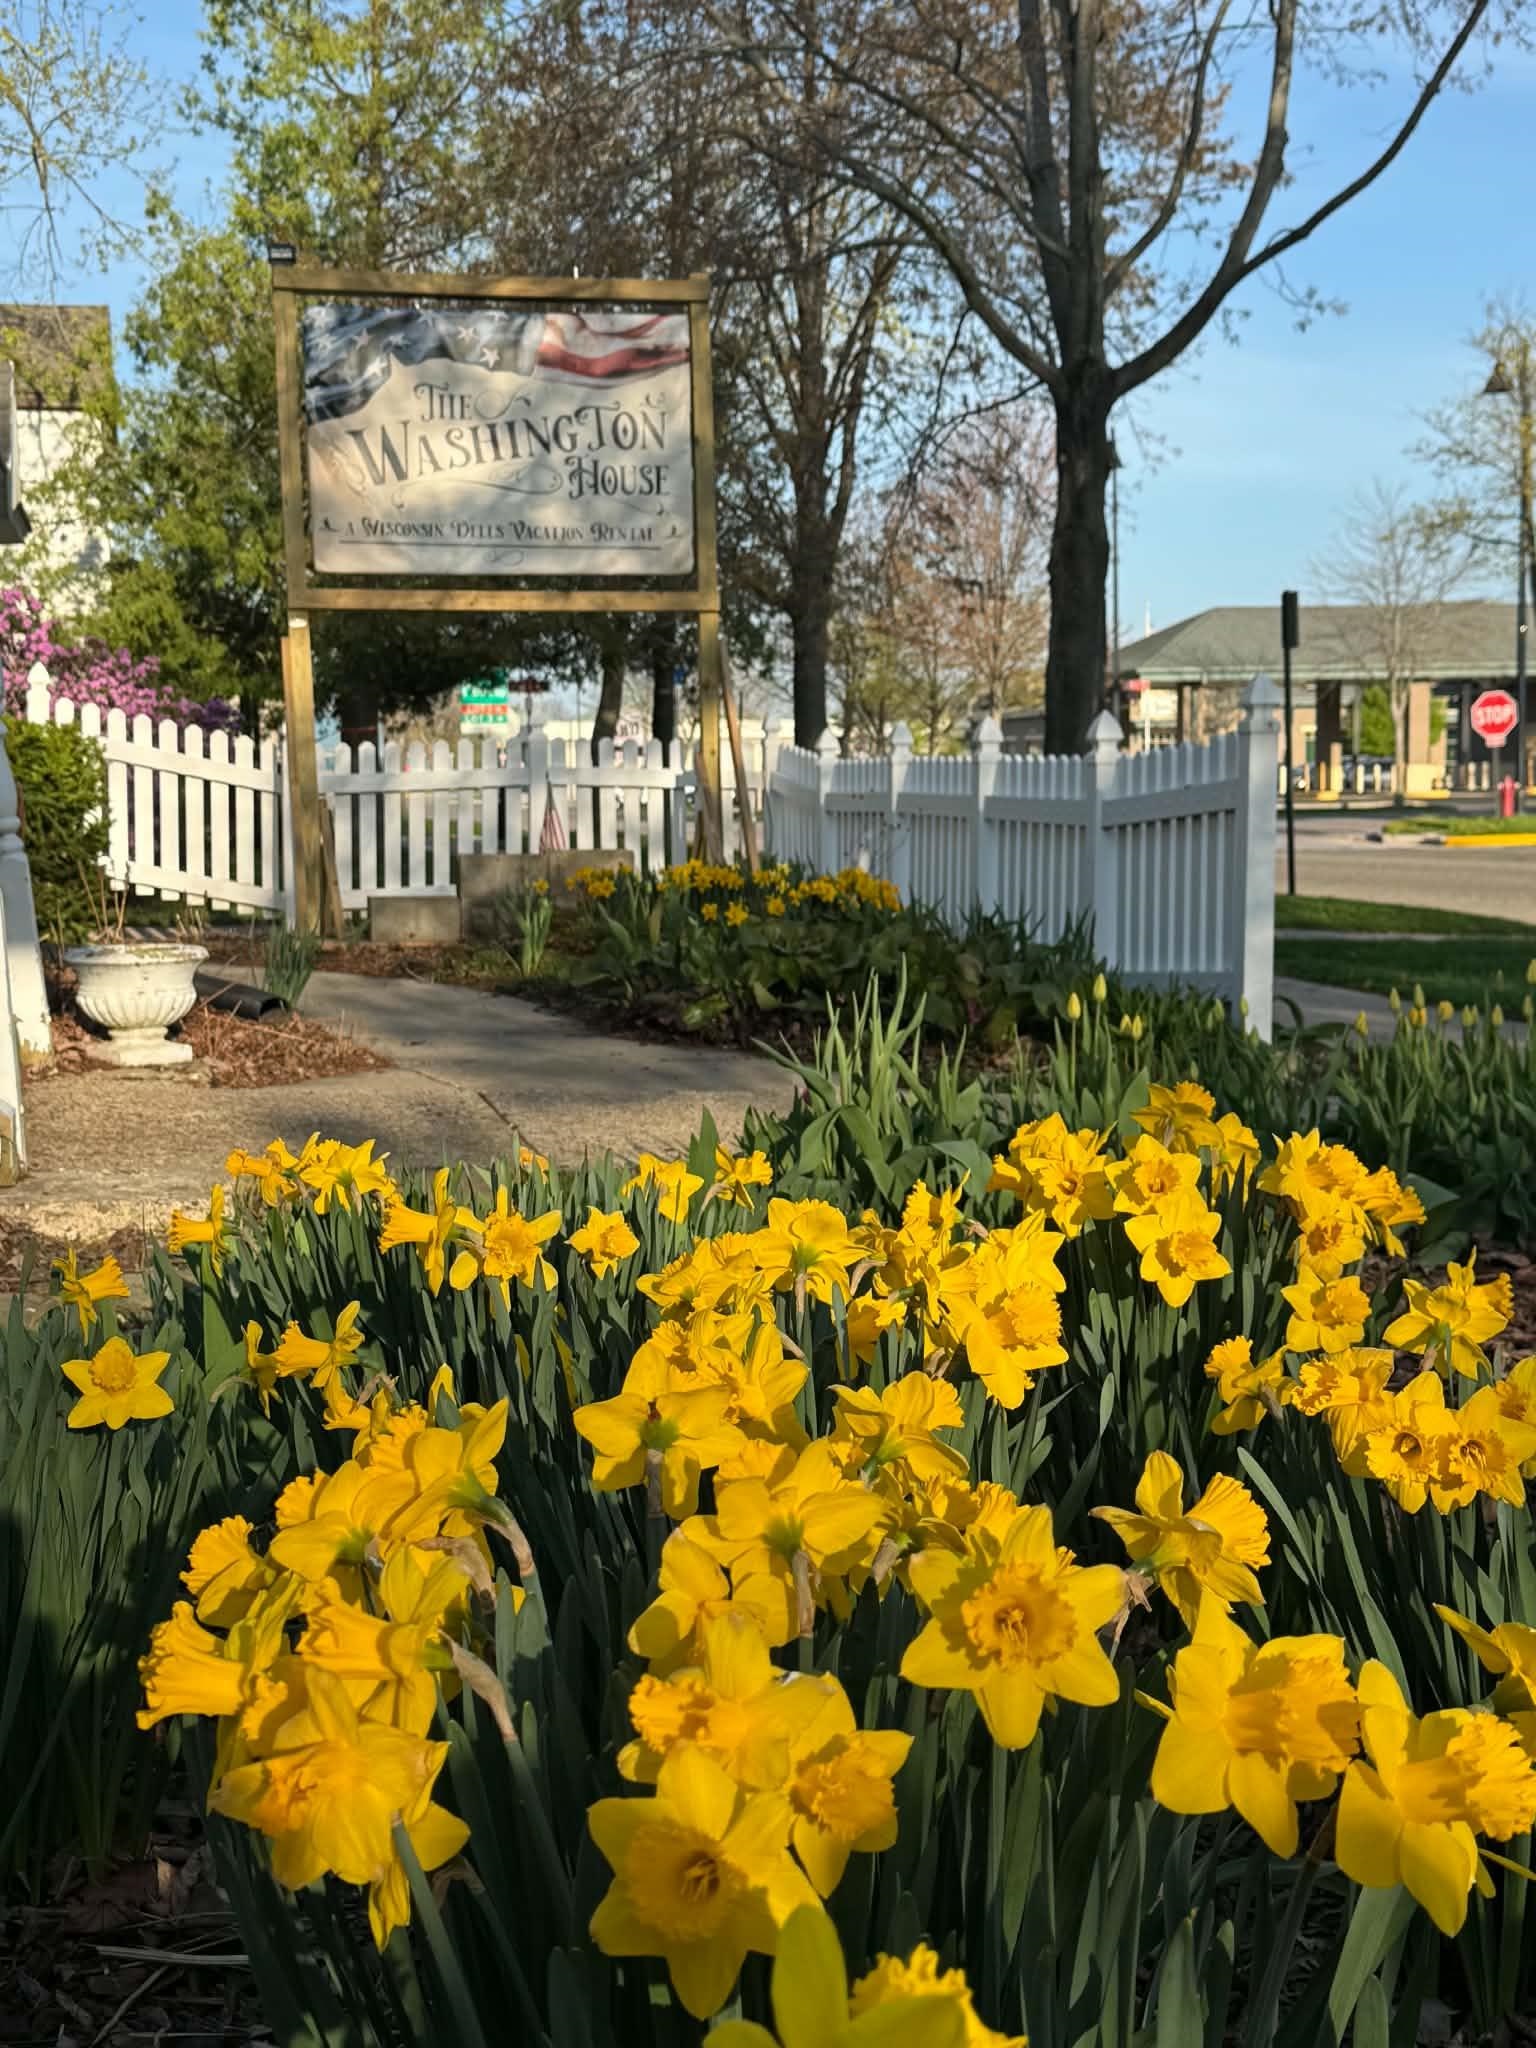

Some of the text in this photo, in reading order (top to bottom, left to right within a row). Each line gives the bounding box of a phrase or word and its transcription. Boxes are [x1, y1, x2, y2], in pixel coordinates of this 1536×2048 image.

[413, 382, 473, 422] THE
[345, 401, 667, 486] WASHINGTON
[564, 455, 670, 500] HOUSE
[344, 521, 356, 536] A
[361, 517, 444, 537] WISCONSIN
[508, 519, 584, 541] VACATION
[590, 520, 655, 542] RENTAL
[1475, 705, 1513, 726] STOP
